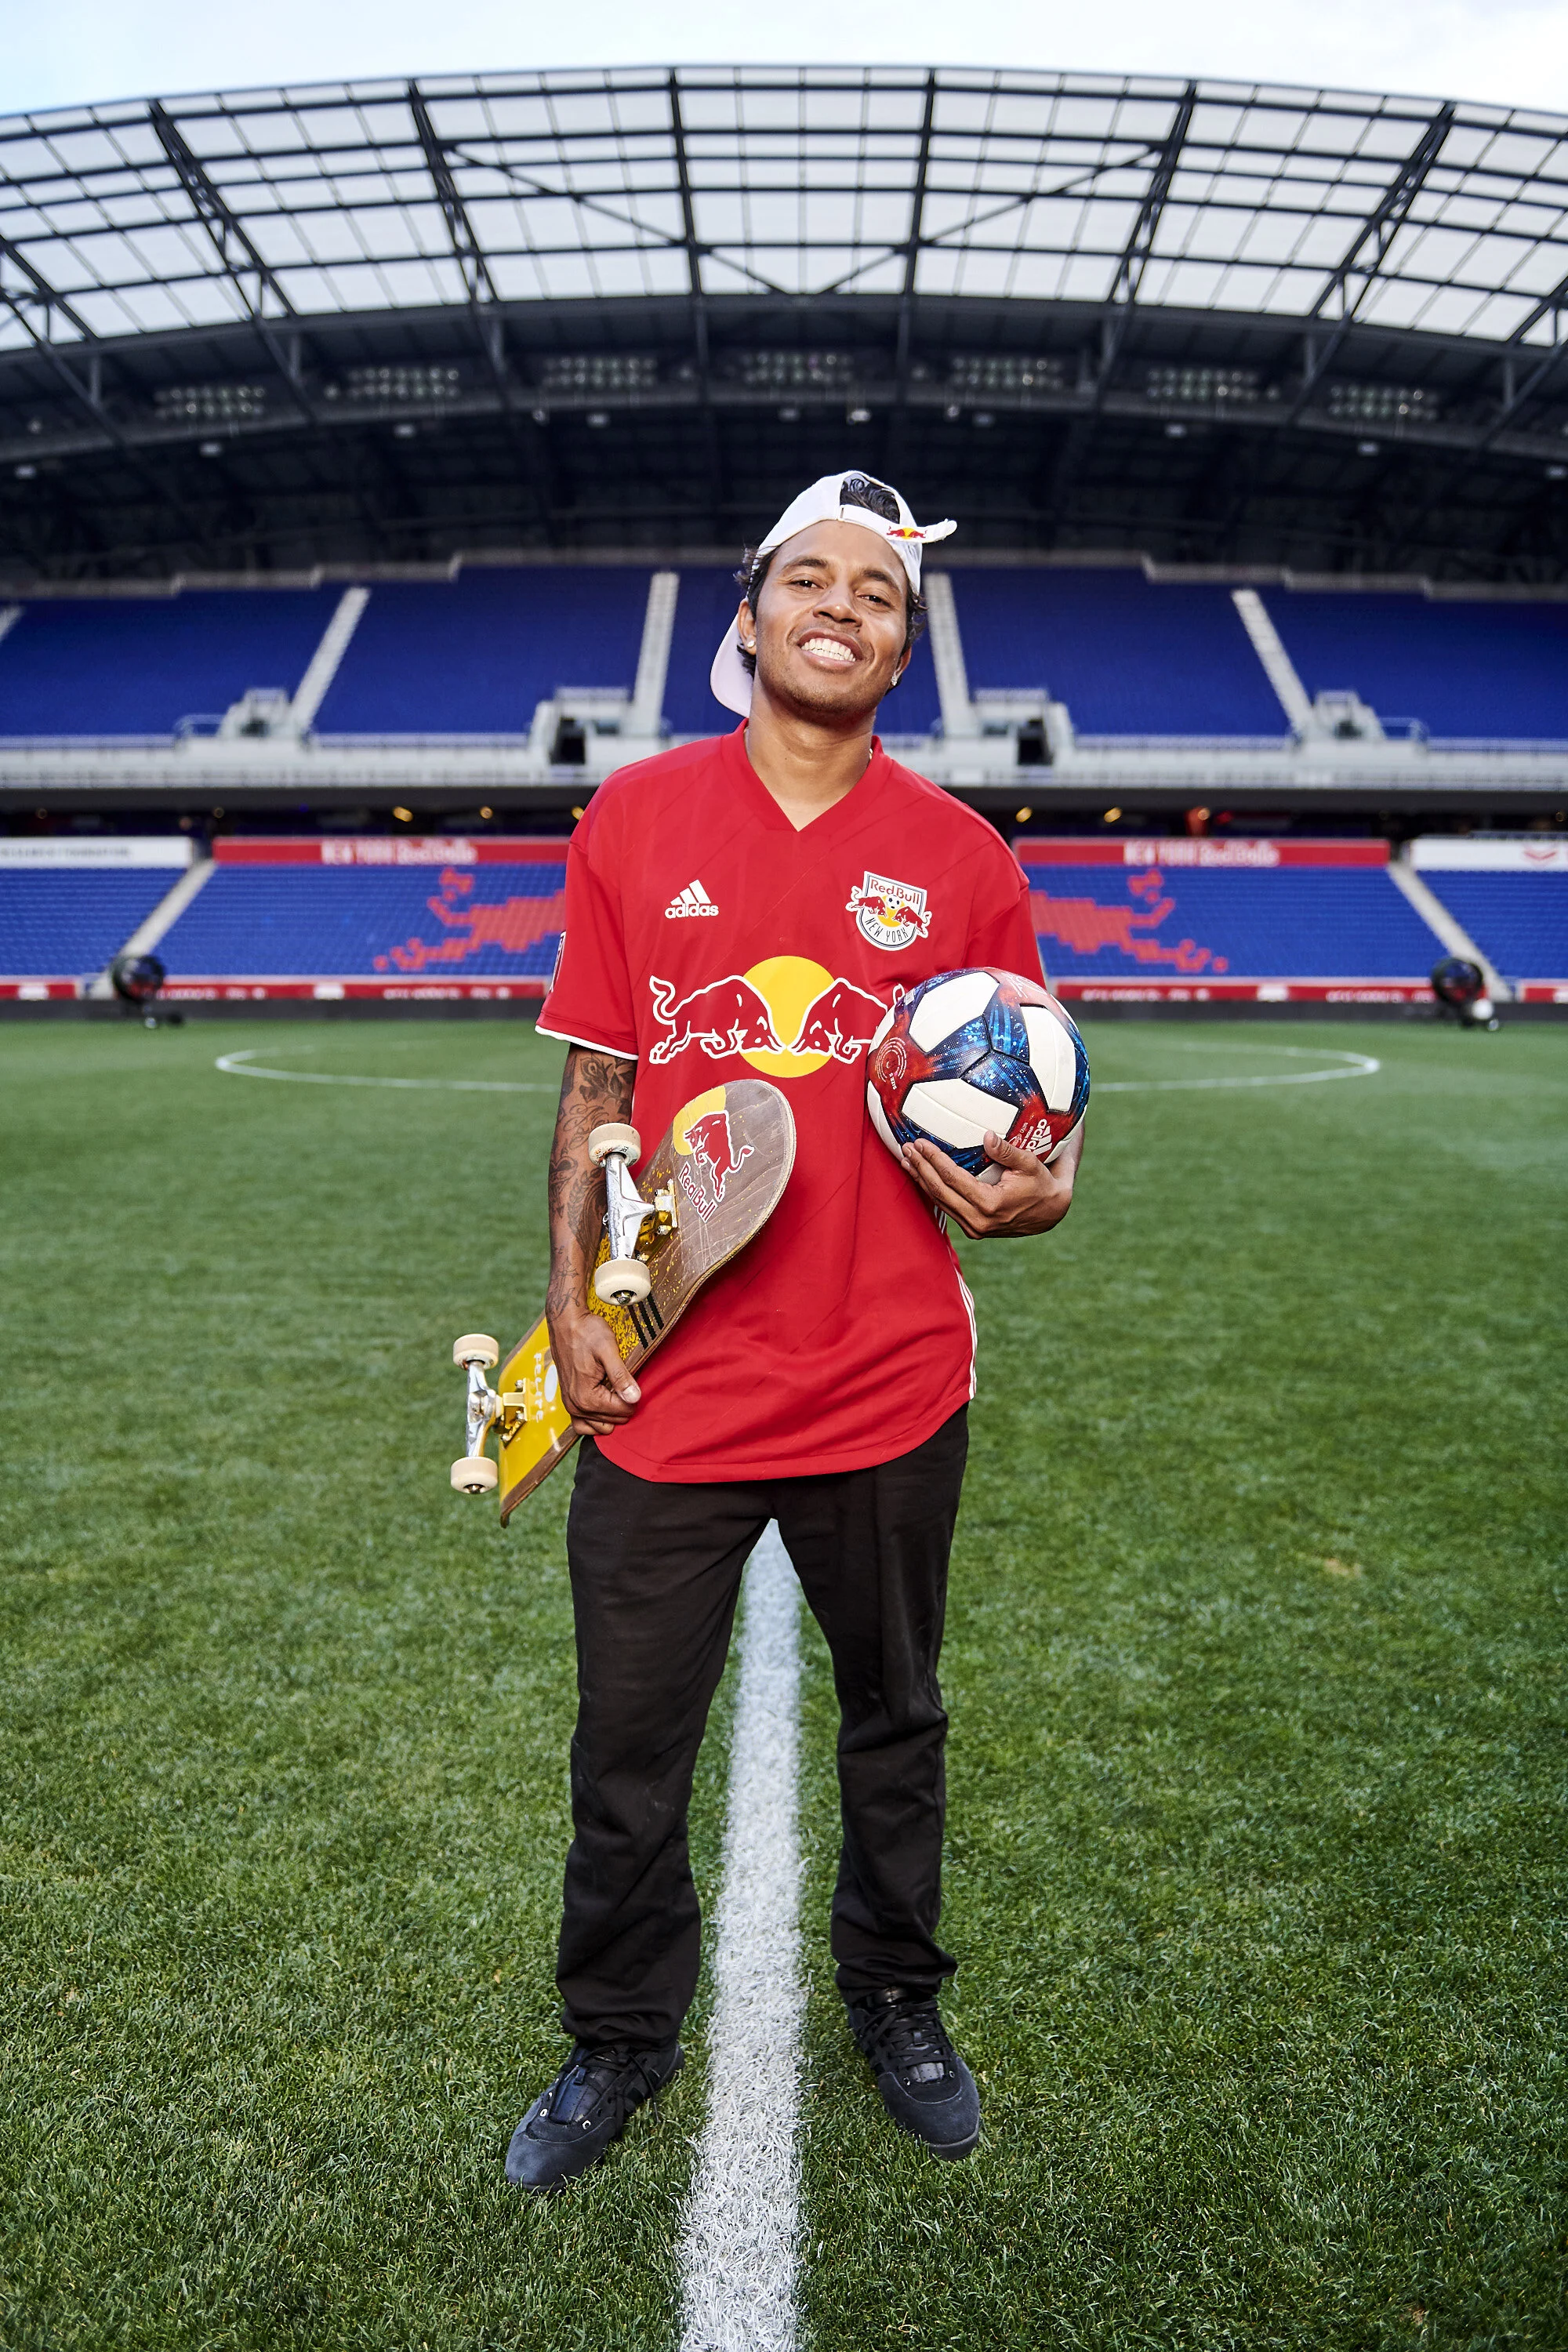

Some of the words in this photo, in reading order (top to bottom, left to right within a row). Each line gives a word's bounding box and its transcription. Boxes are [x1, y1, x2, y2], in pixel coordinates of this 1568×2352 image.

[665, 902, 719, 919] adidas
[865, 917, 884, 938] NEW
[886, 927, 909, 943] YORK
[1025, 1118, 1047, 1152] adid
